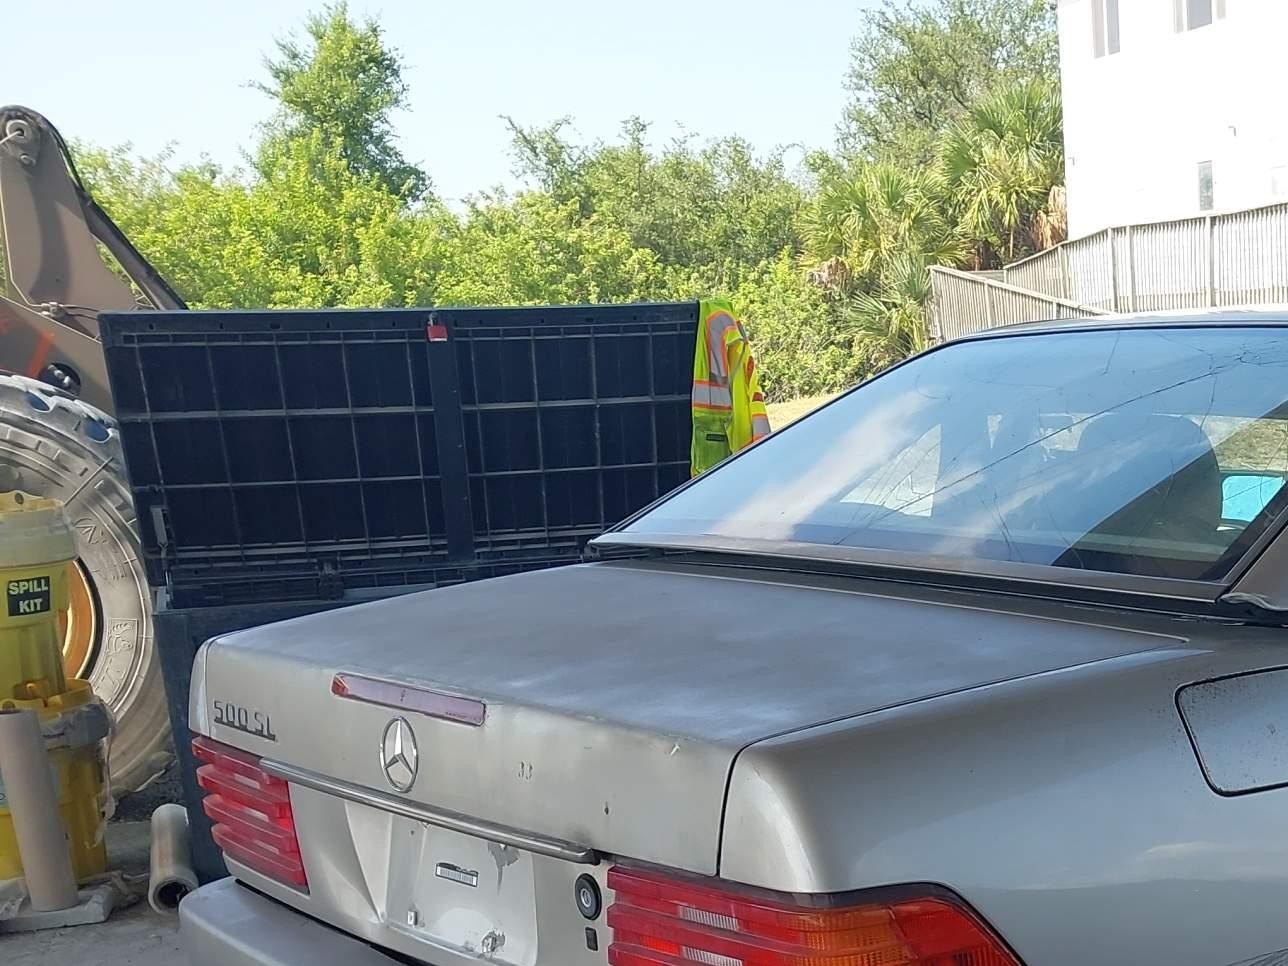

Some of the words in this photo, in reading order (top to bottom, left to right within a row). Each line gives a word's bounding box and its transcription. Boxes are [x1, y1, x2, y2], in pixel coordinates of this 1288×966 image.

[9, 579, 49, 595] SPILL
[19, 598, 43, 613] KIT
[213, 700, 249, 732] 500
